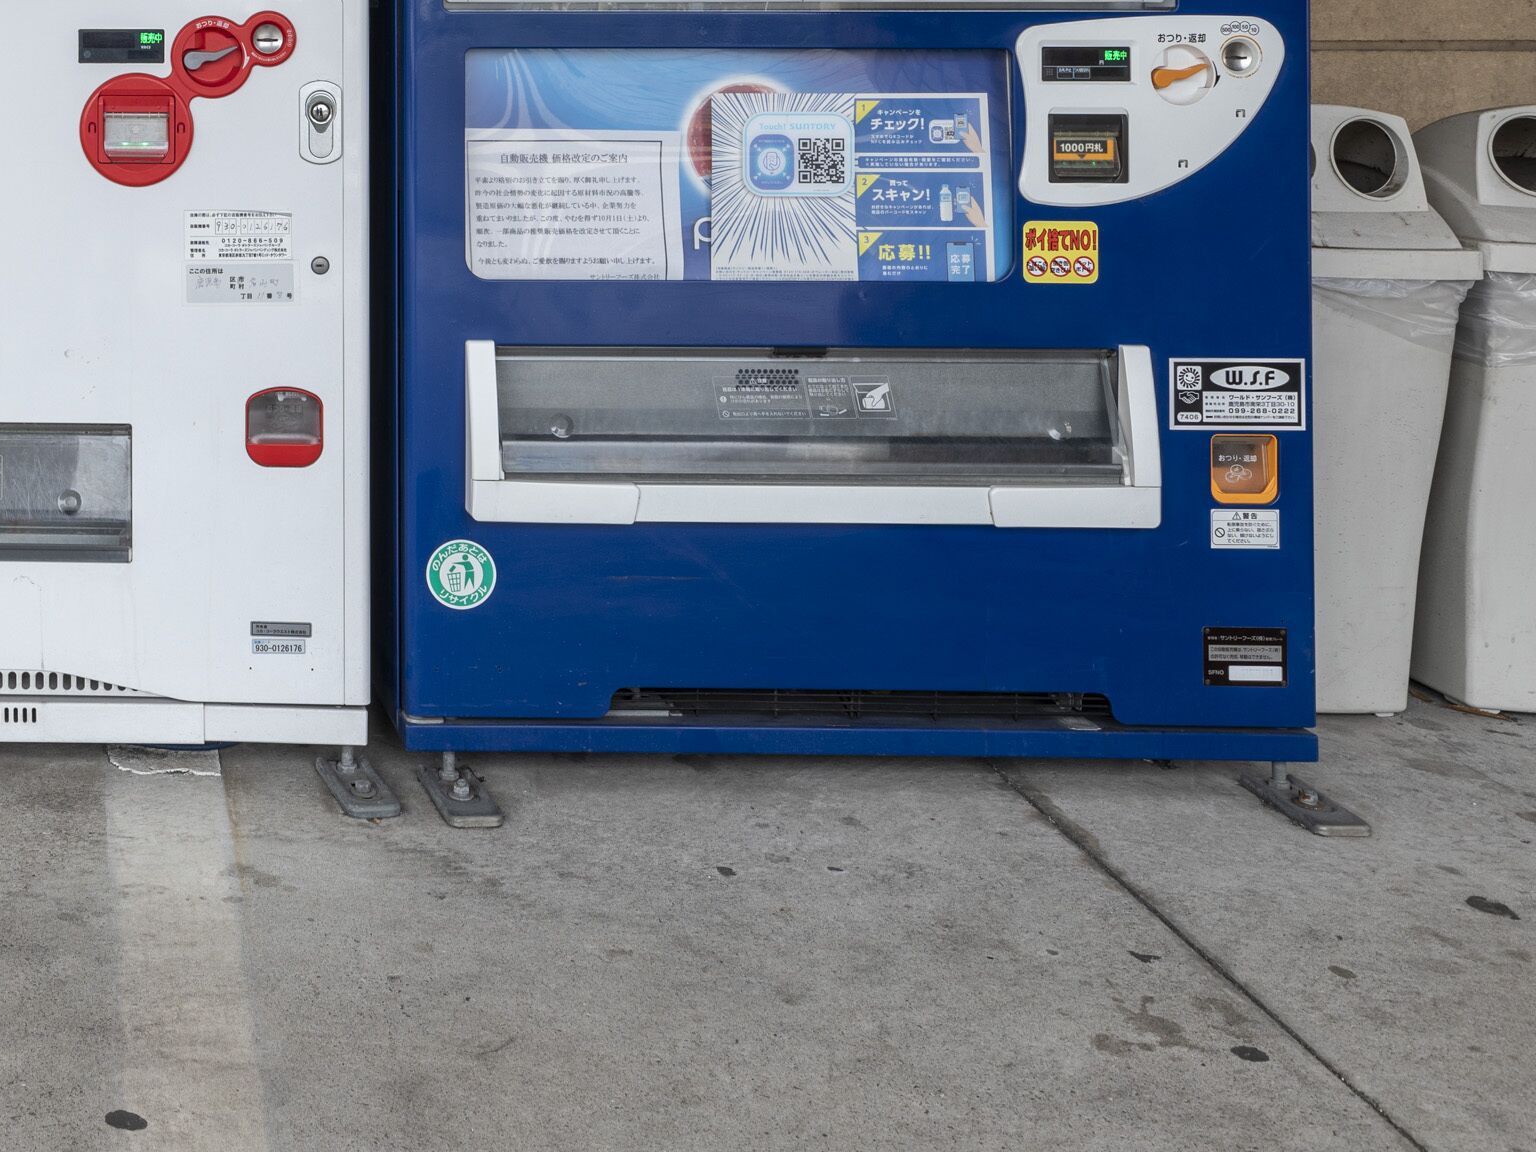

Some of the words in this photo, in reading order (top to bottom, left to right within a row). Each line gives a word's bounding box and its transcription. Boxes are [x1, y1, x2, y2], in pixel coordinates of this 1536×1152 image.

[140, 32, 163, 44] 販売中
[1157, 33, 1206, 43] おつり・返却
[1105, 50, 1127, 60] 販売中
[870, 118, 925, 130] チェック!
[1060, 143, 1103, 153] 1000円札
[501, 154, 548, 164] 自動販売機
[552, 153, 628, 163] 価格改定のご案内
[872, 189, 930, 201] スキャン!
[1025, 228, 1096, 251] ポイ捨てNO!
[879, 244, 931, 261] 応募!!
[950, 254, 970, 263] 応募
[951, 266, 970, 274] 完了
[1225, 370, 1275, 385] W.S.F
[1243, 512, 1258, 520] 警告
[432, 544, 487, 571] のんだあとは
[440, 586, 487, 604] リサイクル
